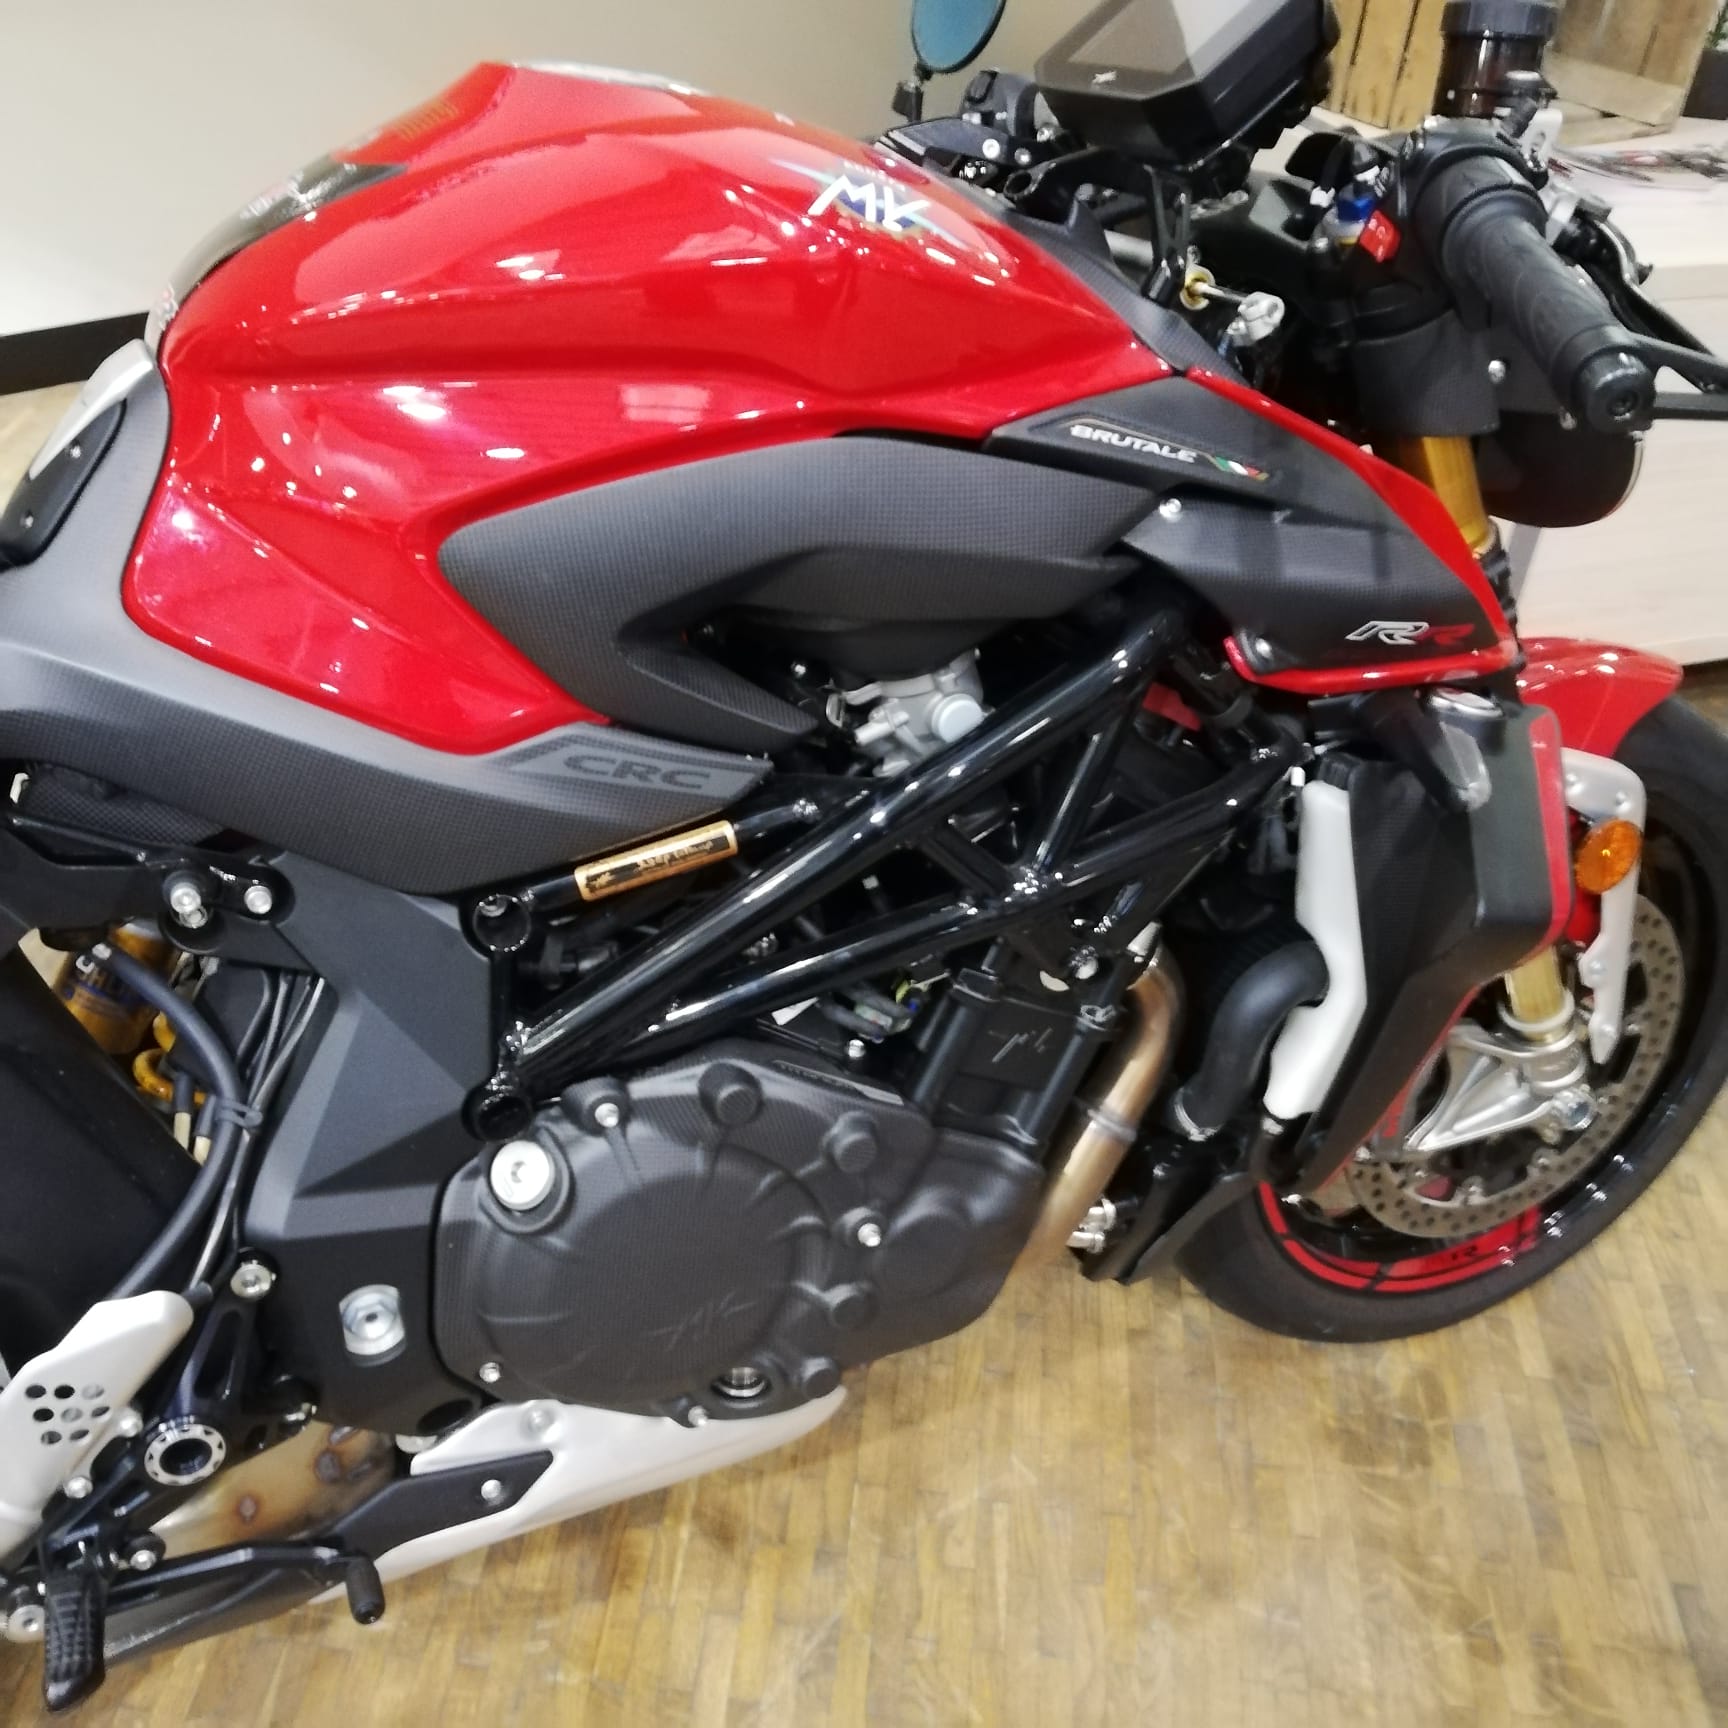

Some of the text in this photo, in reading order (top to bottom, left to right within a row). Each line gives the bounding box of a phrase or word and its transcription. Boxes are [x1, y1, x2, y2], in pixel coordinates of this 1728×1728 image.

[1070, 424, 1198, 464] BRUTALE
[1344, 620, 1475, 646] RR
[563, 755, 711, 789] CRC
